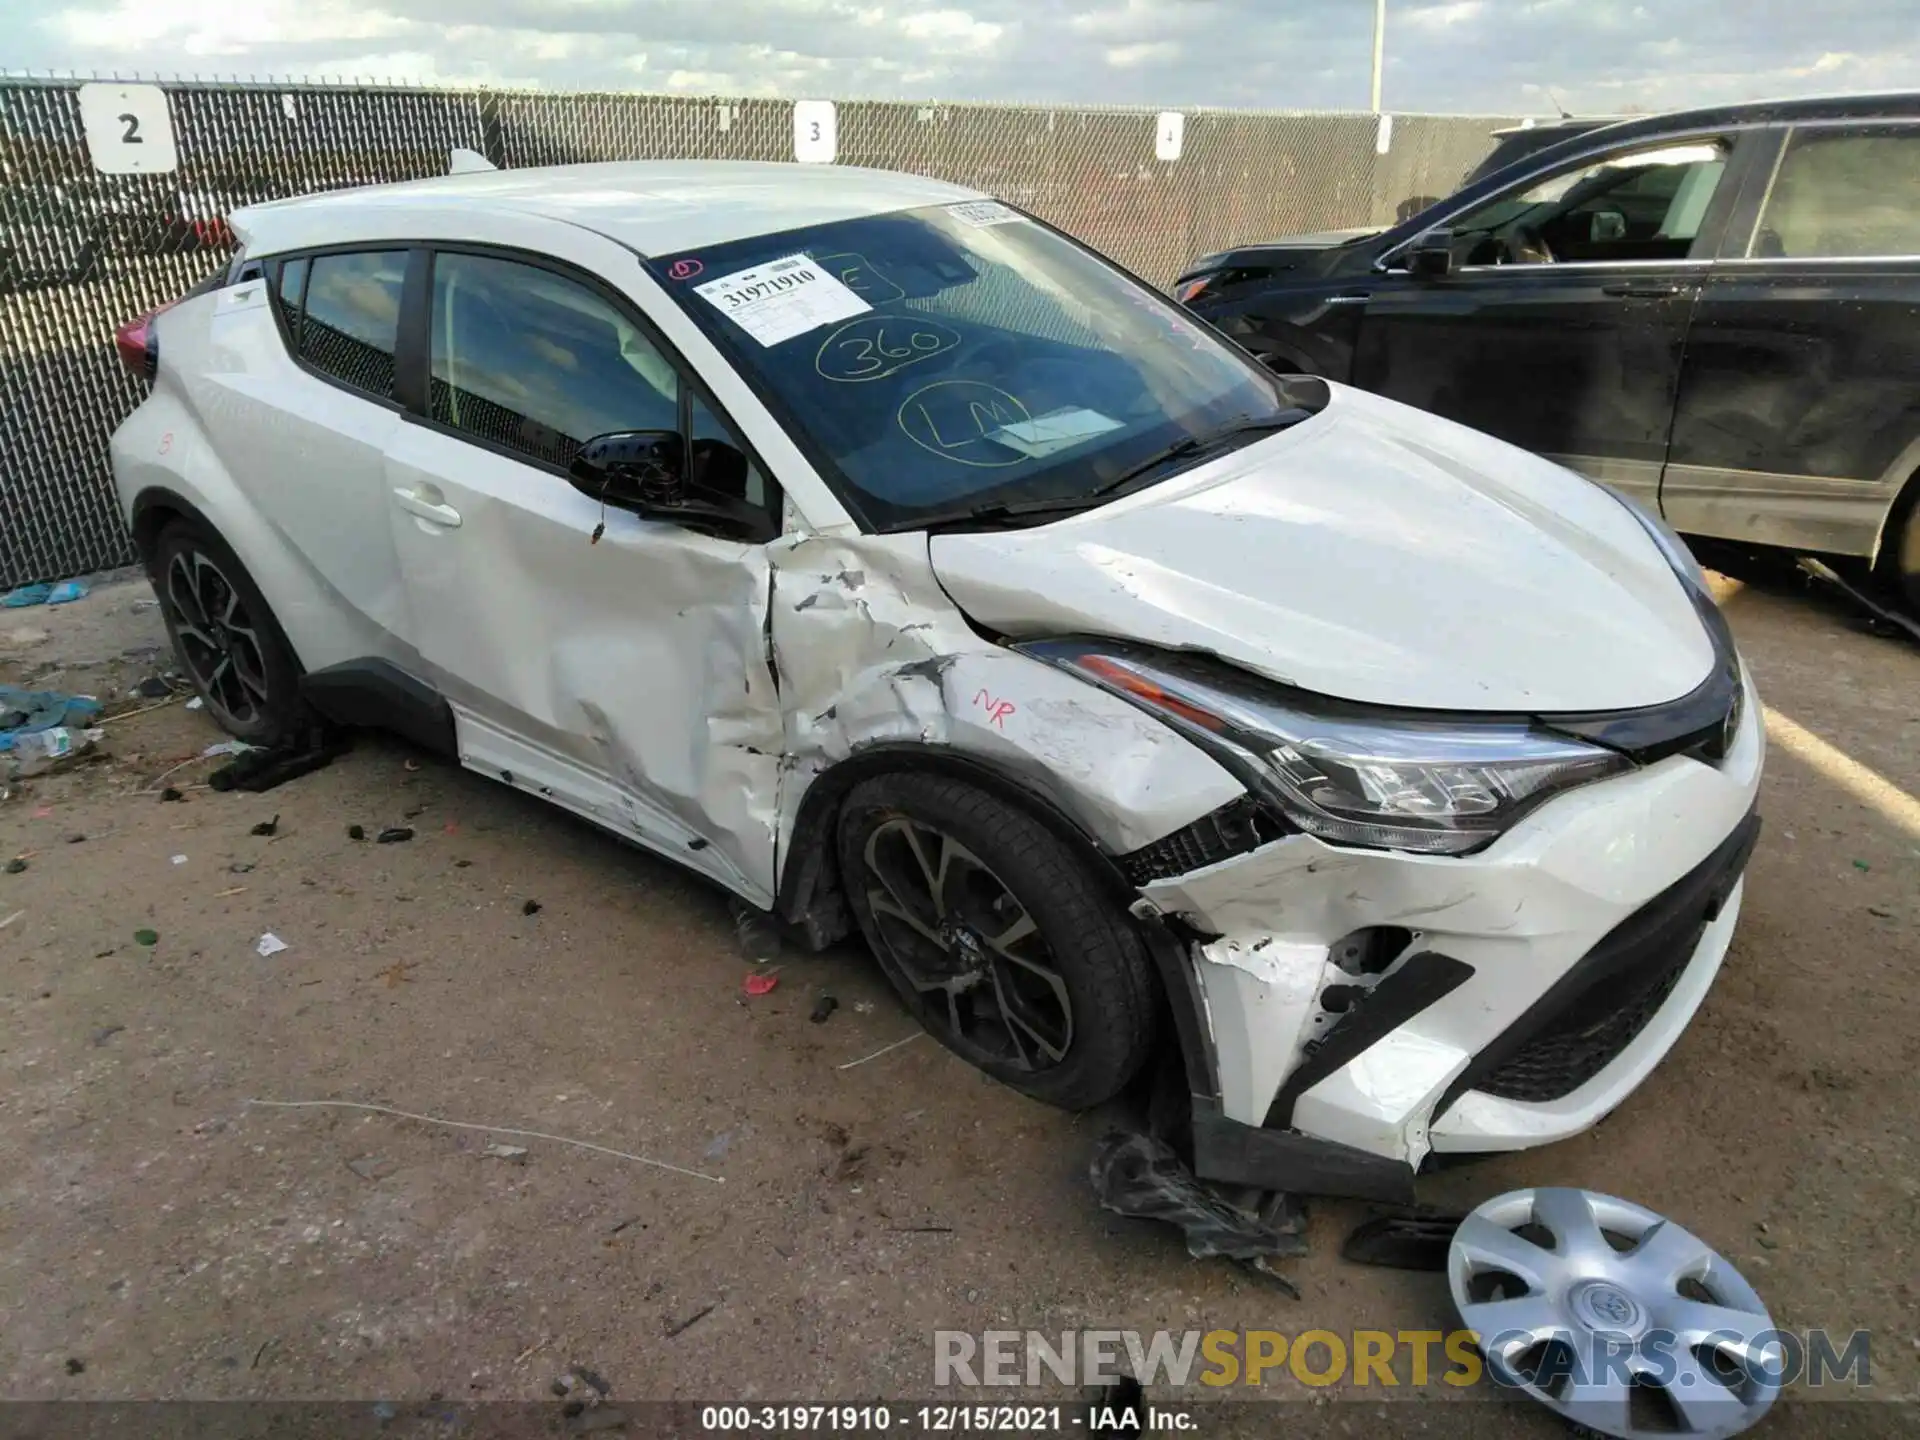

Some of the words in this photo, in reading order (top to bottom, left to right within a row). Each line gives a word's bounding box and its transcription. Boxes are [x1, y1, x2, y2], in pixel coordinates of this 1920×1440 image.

[117, 113, 143, 143] 2
[810, 121, 820, 141] 3
[722, 270, 817, 308] 31971910
[839, 328, 940, 375] 360
[973, 688, 1016, 729] NR
